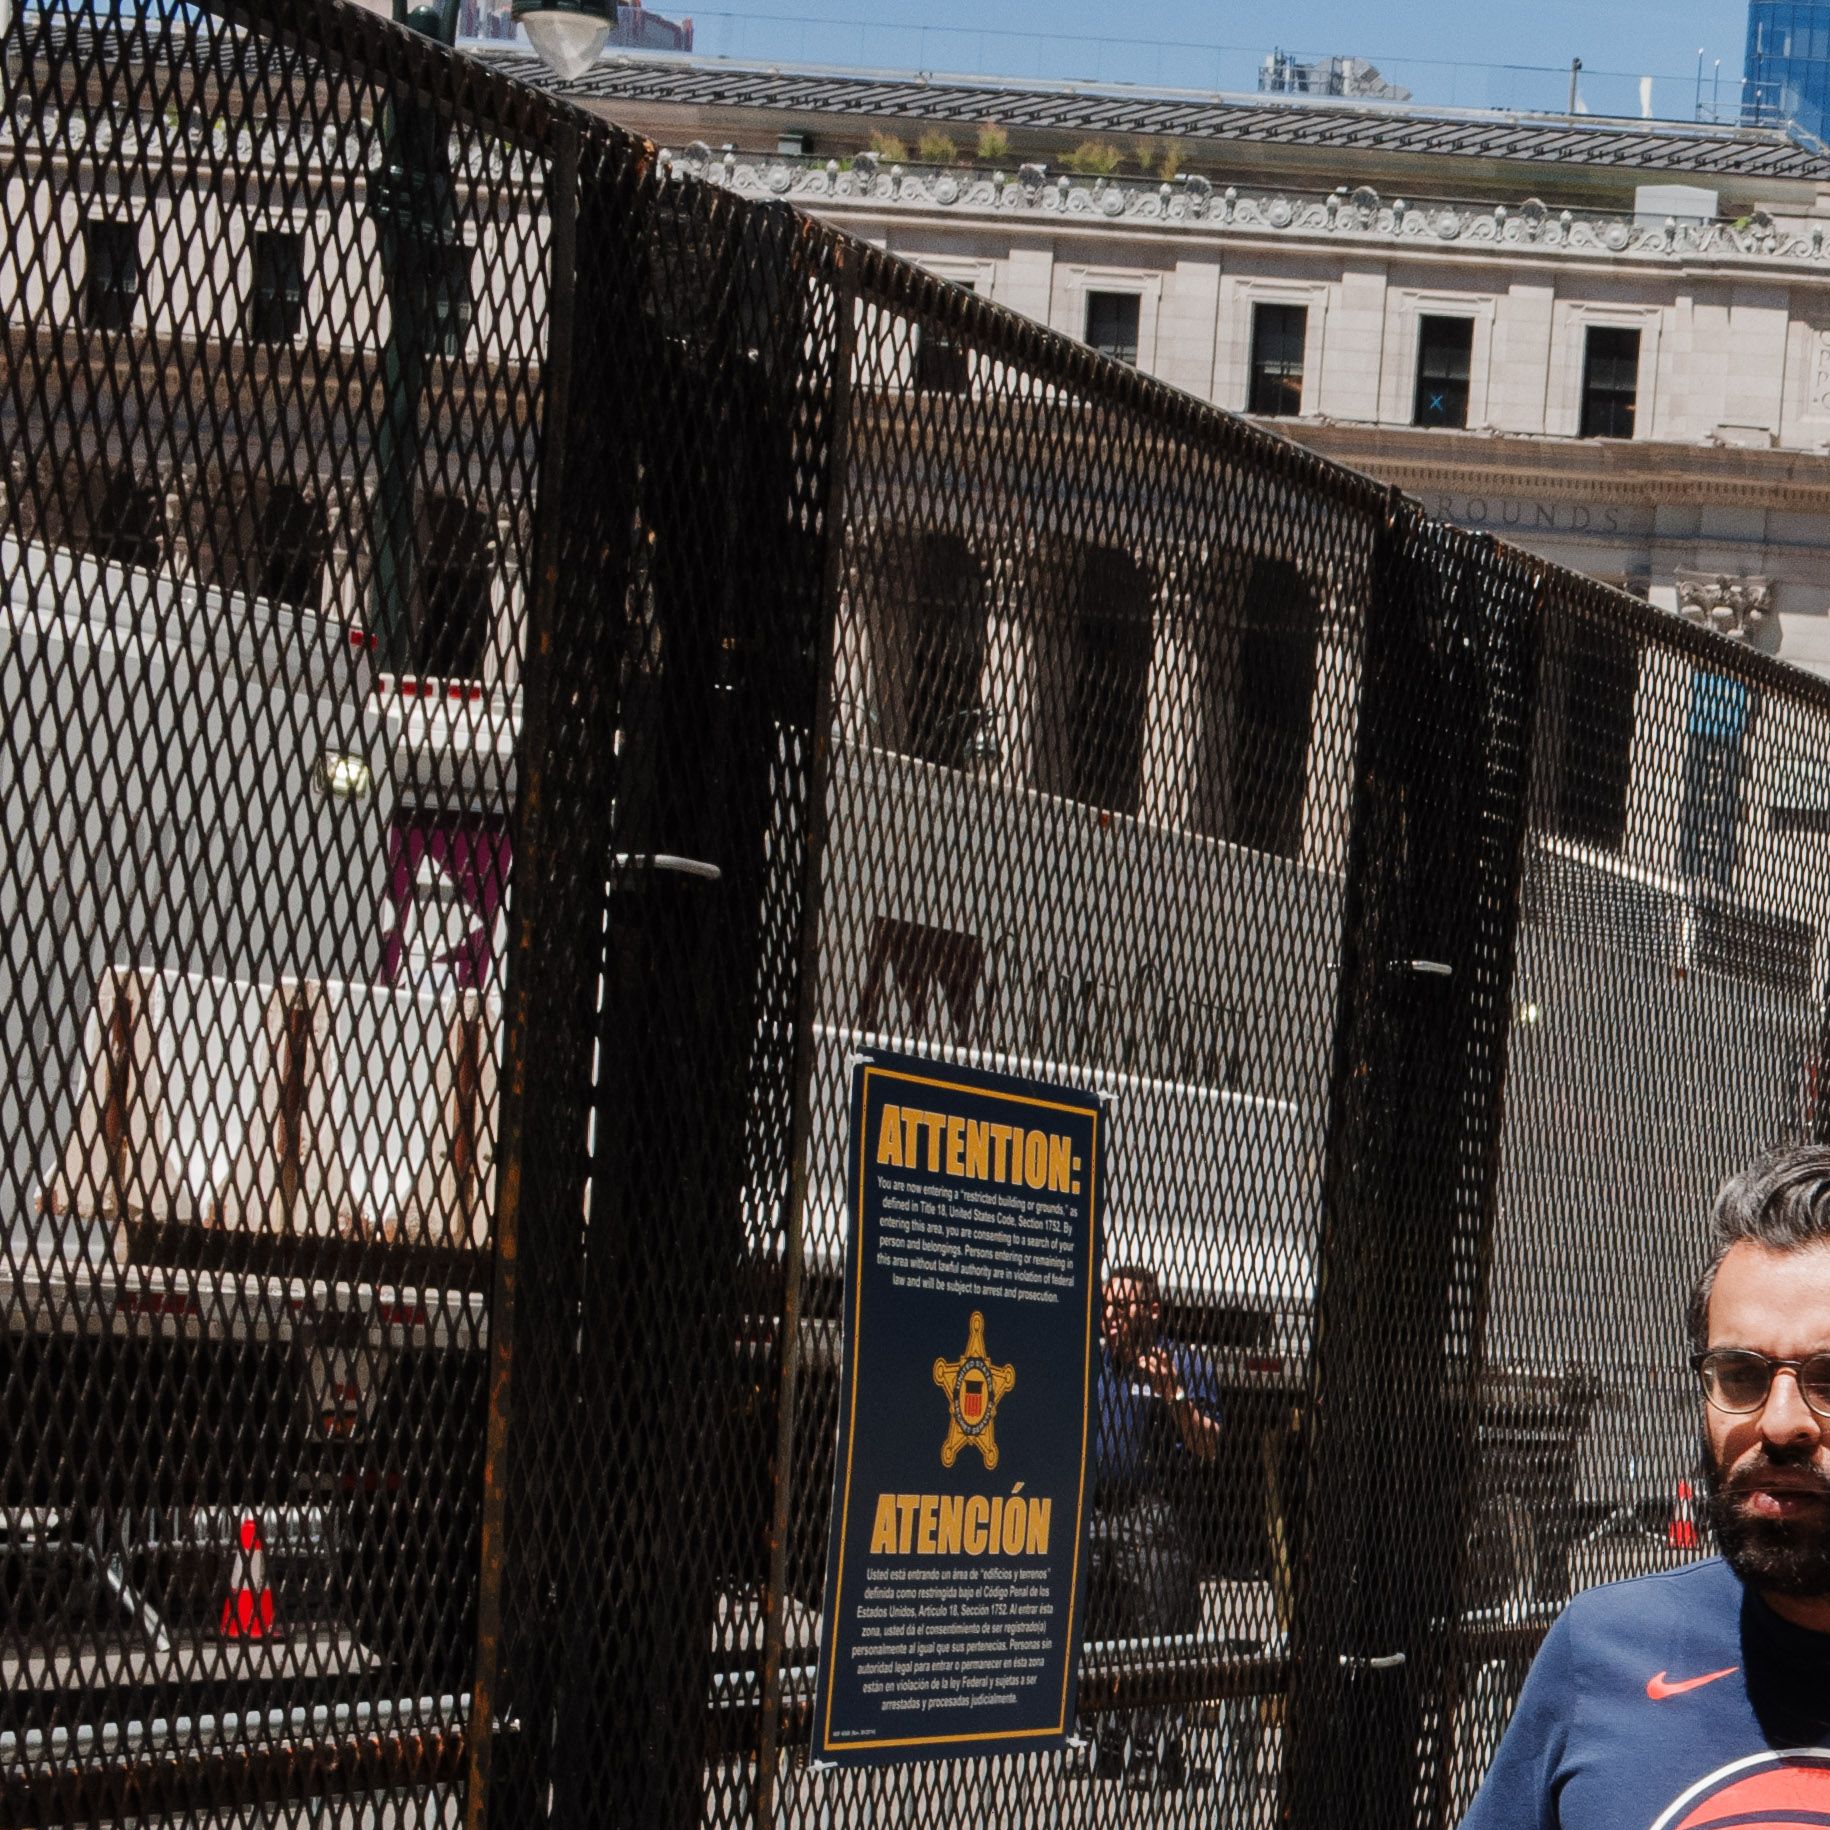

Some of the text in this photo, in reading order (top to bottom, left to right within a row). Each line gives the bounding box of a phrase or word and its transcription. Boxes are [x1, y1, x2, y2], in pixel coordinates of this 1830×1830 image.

[877, 1104, 1081, 1194] ATTENTION:
[877, 1177, 892, 1190] You
[893, 1181, 905, 1191] are
[906, 1183, 922, 1194] now
[923, 1185, 953, 1202] entering
[998, 1194, 1026, 1212] building
[1027, 1201, 1035, 1211] or
[1070, 1207, 1078, 1217] as
[882, 1196, 910, 1211] defined
[911, 1201, 919, 1212] in
[920, 1202, 936, 1215] Title
[949, 1206, 972, 1220] United
[973, 1209, 995, 1223] States
[997, 1212, 1017, 1228] Code,
[1018, 1216, 1044, 1230] Section
[1063, 1222, 1073, 1237] By
[879, 1217, 1074, 1253] entering this area, you are consenting to search of your
[879, 1236, 1073, 1273] person and belongings. Persons entering or remaining in
[877, 1254, 1074, 1287] this area without lawful authority are in violation of federal
[893, 1274, 1059, 1303] law and will be subject to arrest and prosecution.
[870, 1481, 1052, 1555] ATENCIÓN
[866, 1569, 889, 1581] Usted
[889, 1569, 906, 1581] está
[907, 1569, 940, 1580] entrando
[941, 1571, 950, 1580] un
[952, 1568, 968, 1580] área
[969, 1568, 979, 1580] de
[864, 1585, 1050, 1601] definida como restringida bajo el Código Penal de los
[857, 1606, 887, 1618] Estados
[889, 1606, 917, 1619] Unidos,
[918, 1605, 948, 1617] Artículo
[960, 1604, 990, 1616] Sección
[1009, 1603, 1018, 1615] Al
[1018, 1604, 1039, 1615] entrar
[861, 1628, 882, 1638] zona,
[883, 1624, 905, 1636] usted
[917, 1624, 924, 1636] el
[925, 1624, 980, 1635] consentimiento
[981, 1623, 990, 1634] de
[991, 1625, 1003, 1634] ser
[851, 1638, 1053, 1659] personalmente al igual que sus Personas sin
[857, 1662, 894, 1674] autoridad
[894, 1661, 913, 1676] legal
[913, 1663, 930, 1675] para
[931, 1661, 954, 1671] entrar
[961, 1660, 1002, 1673] permanecer
[1003, 1659, 1012, 1668] en
[1028, 1658, 1045, 1667] zona
[862, 1676, 1038, 1693] están en violación de la ley Federal sujetas ser
[881, 1693, 1018, 1712] arrestadas procesadas judicialmente.
